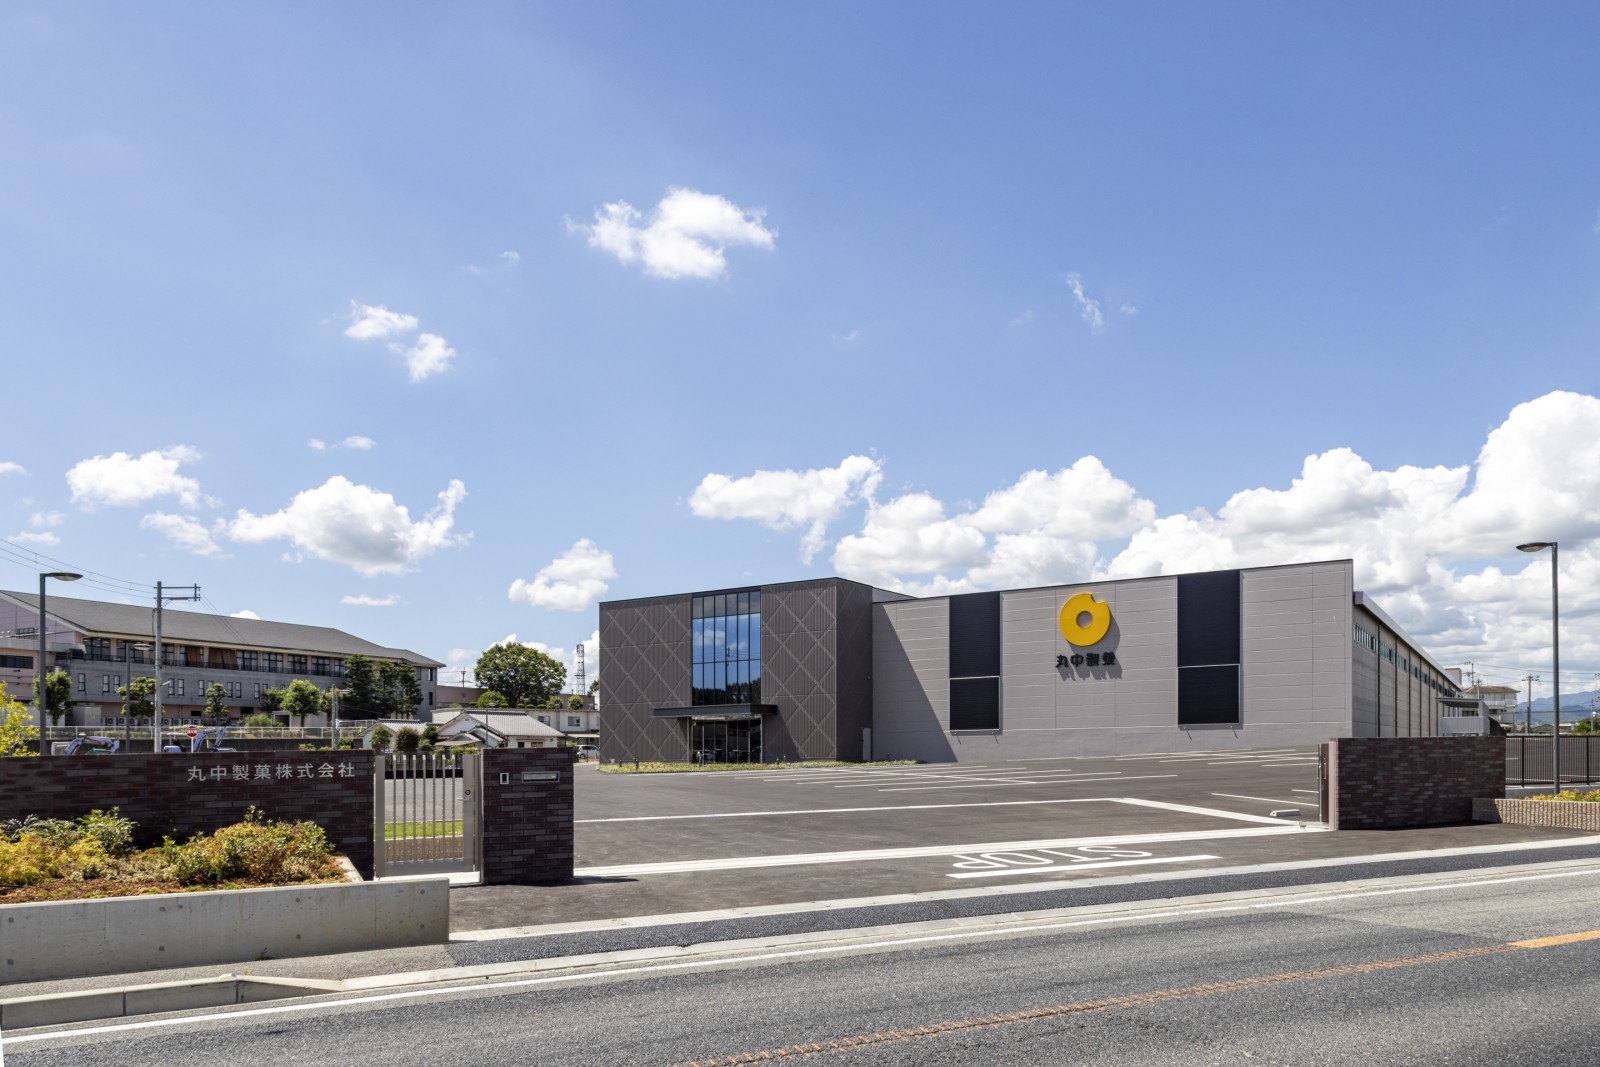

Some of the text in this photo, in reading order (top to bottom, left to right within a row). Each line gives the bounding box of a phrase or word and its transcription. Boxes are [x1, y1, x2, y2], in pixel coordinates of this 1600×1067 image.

[187, 762, 356, 782] 丸中製菓株式会社
[952, 845, 1153, 869] STOP
